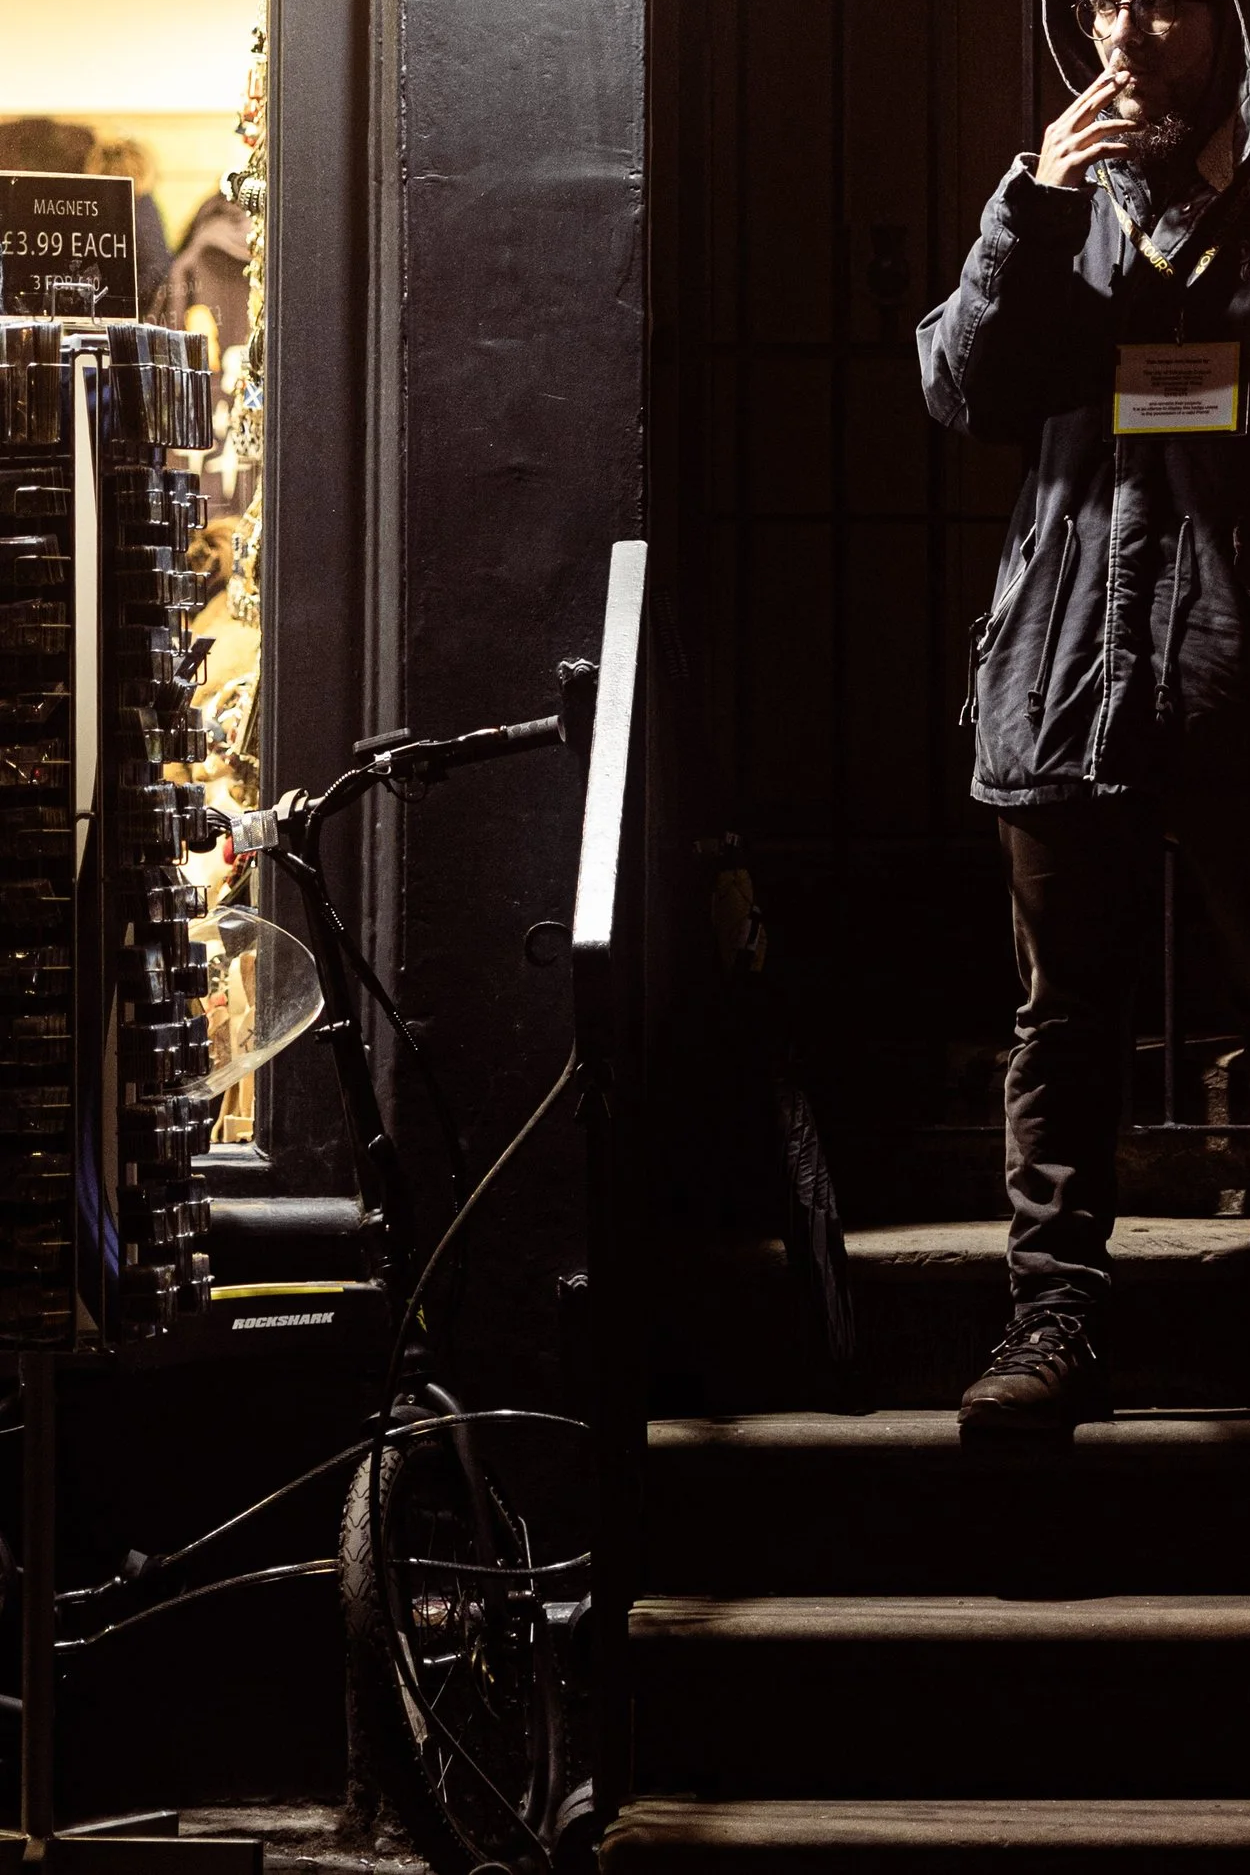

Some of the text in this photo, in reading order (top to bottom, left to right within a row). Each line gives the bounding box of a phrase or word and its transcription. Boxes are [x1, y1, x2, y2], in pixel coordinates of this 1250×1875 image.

[33, 198, 99, 217] MAGNETS
[1, 230, 127, 259] £3.99 EACH
[1139, 236, 1175, 279] TOURS
[32, 275, 41, 291] 3
[45, 274, 73, 291] FOR
[231, 1311, 335, 1330] ROCKSHARK
